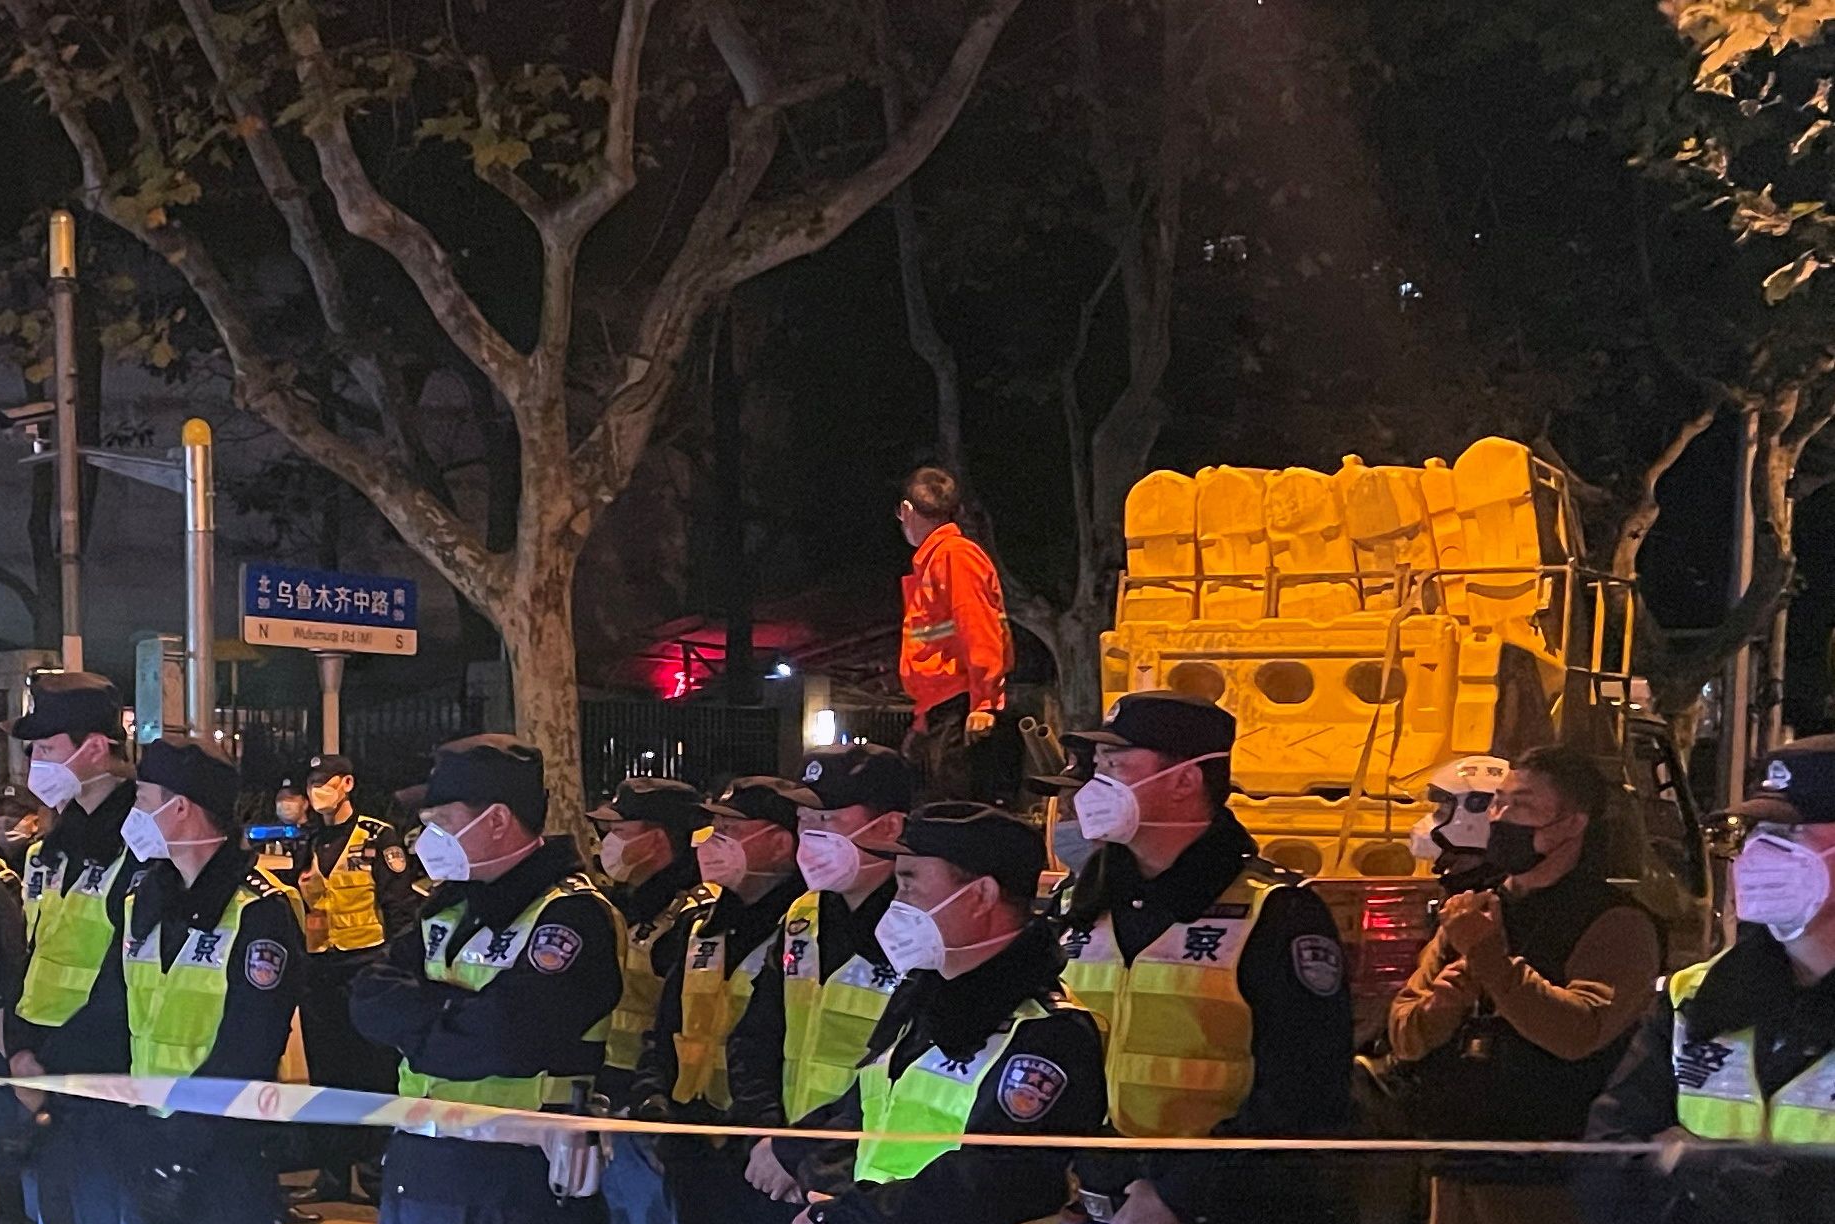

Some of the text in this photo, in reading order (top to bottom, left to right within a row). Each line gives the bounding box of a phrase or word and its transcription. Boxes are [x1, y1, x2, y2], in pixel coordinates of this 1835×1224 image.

[276, 580, 389, 616] 乌鲁木齐中路
[259, 624, 269, 639] N
[395, 634, 404, 649] S
[1182, 923, 1227, 961] 察
[1675, 1040, 1734, 1089] 警
